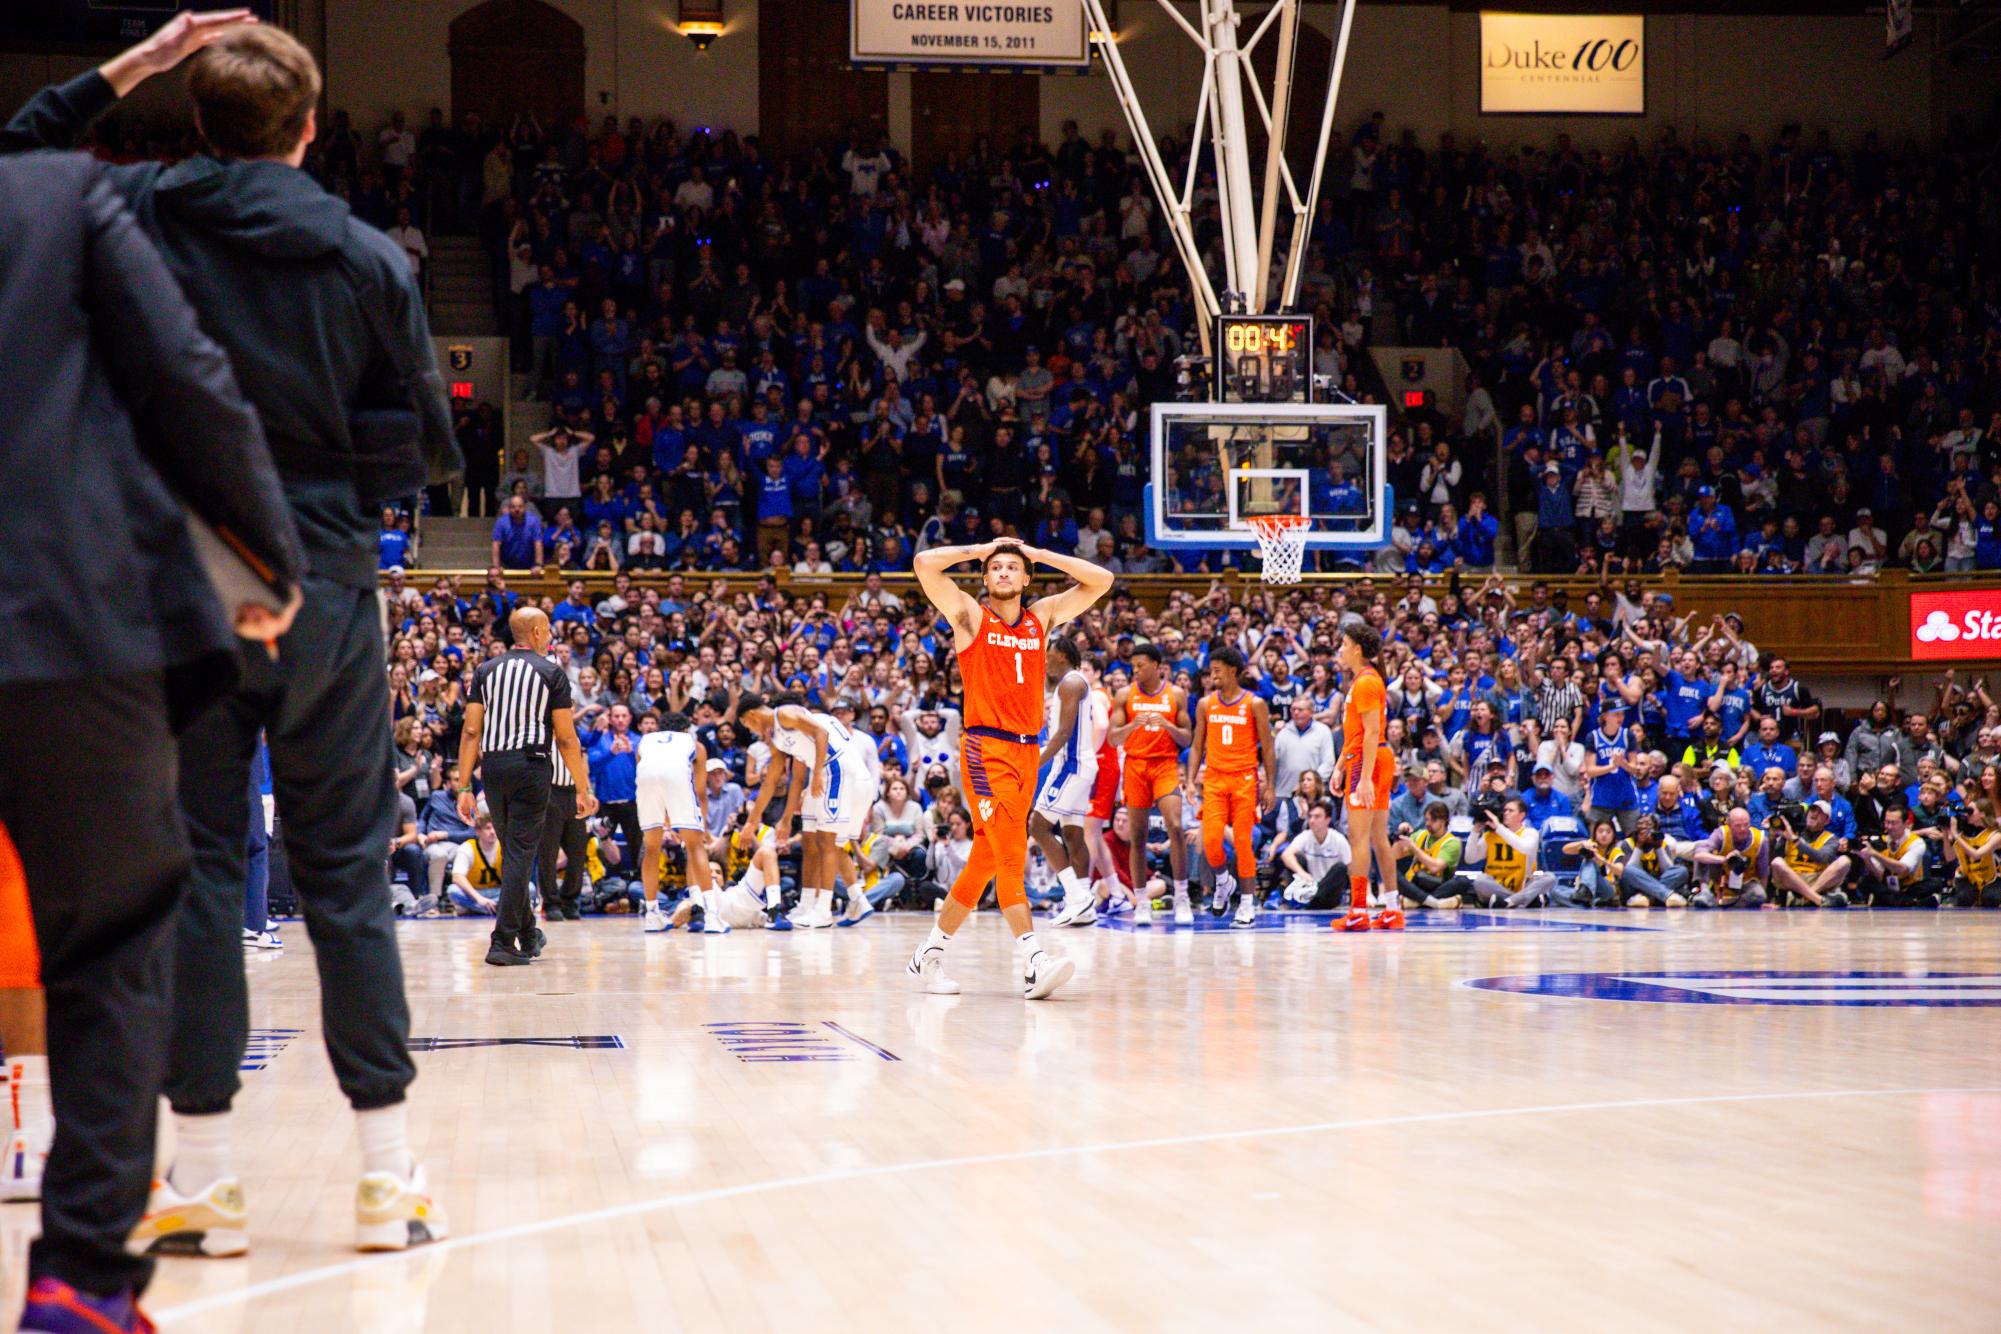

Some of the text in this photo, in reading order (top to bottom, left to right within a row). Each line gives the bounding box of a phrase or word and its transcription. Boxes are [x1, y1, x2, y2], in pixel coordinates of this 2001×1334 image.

[893, 4, 1053, 23] CAREER VICTORIES
[911, 34, 1035, 49] NOVEMBER 15, 2011
[1487, 38, 1639, 72] Duke 100
[1520, 74, 1600, 84] CENTENNIAL
[1014, 652, 1024, 684] 1
[1221, 724, 1233, 746] 0
